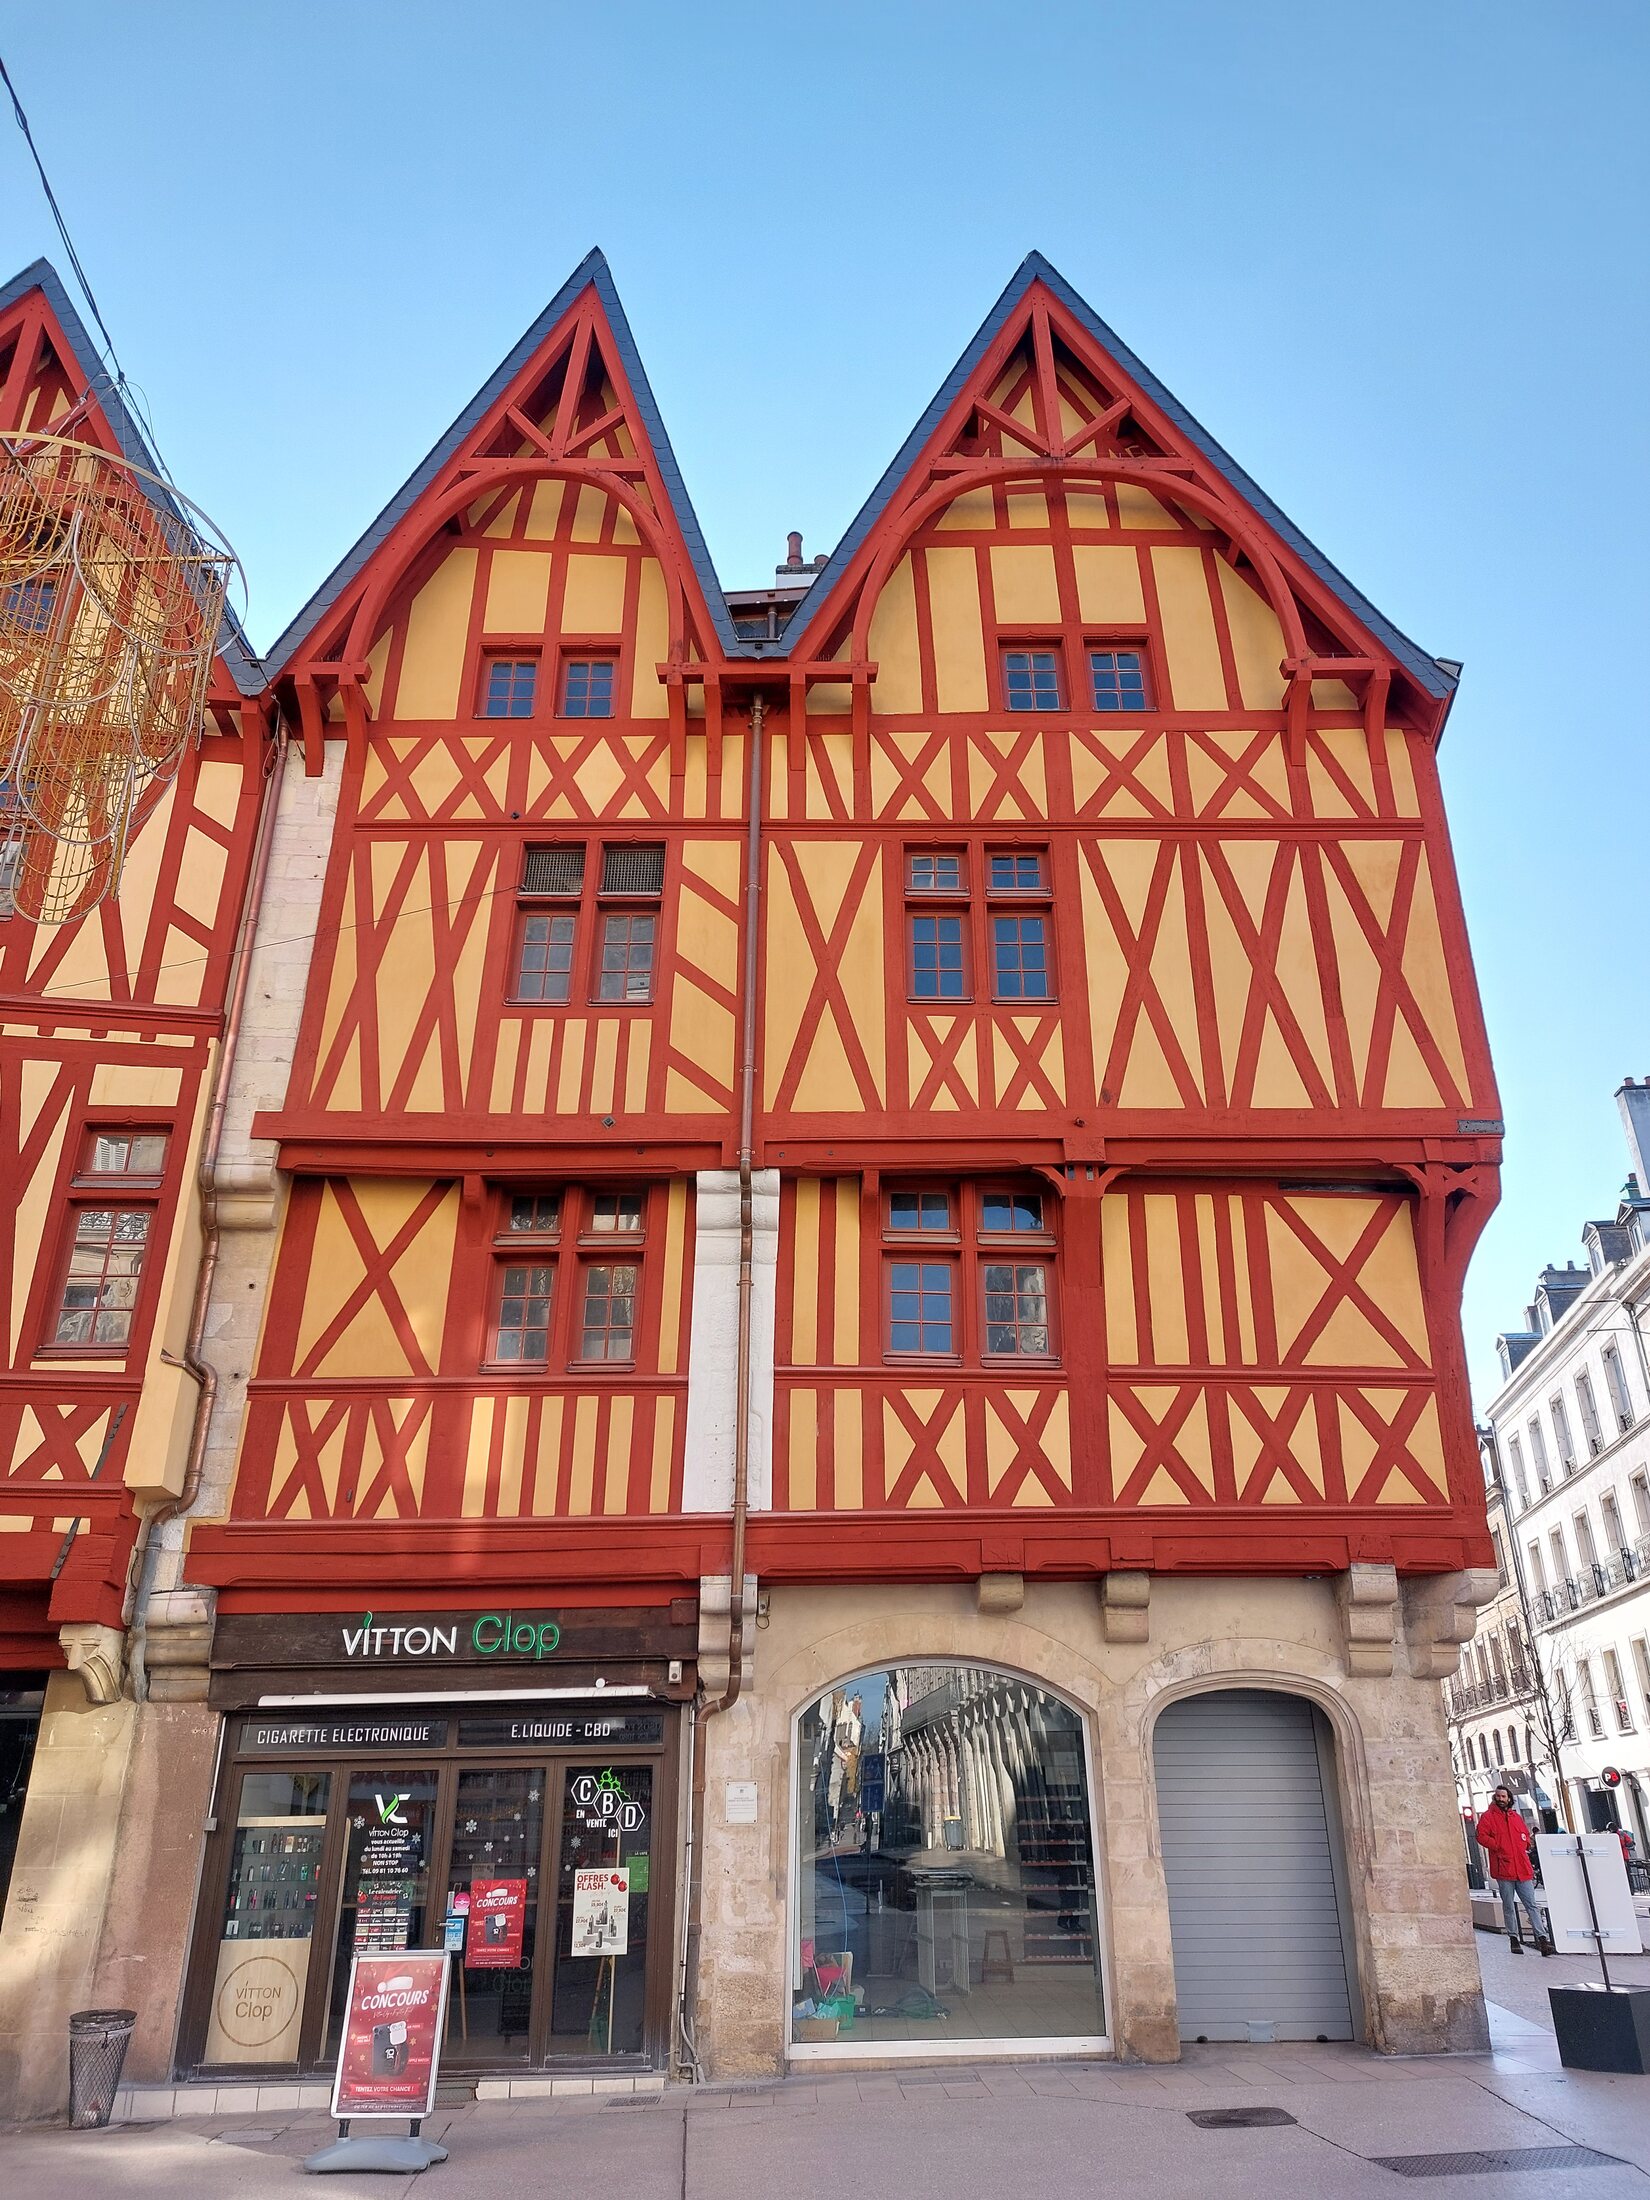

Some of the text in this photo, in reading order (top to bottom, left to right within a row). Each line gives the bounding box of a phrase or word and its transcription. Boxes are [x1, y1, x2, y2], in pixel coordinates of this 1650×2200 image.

[472, 1615, 560, 1659] Clop
[257, 1726, 430, 1744] CIGARETTE ELECTRONIQUE
[511, 1723, 573, 1738] E.LIQUIDE
[584, 1722, 611, 1737] CBD
[576, 1810, 585, 1819] EN
[586, 1819, 608, 1828] VENTE
[390, 1827, 409, 1838] Clop
[608, 1828, 618, 1838] ICI
[577, 1874, 609, 1883] OFFRES
[476, 1896, 519, 1908] CONCOURS
[361, 1989, 430, 2011] CONCOURS
[235, 2001, 273, 2021] Clop
